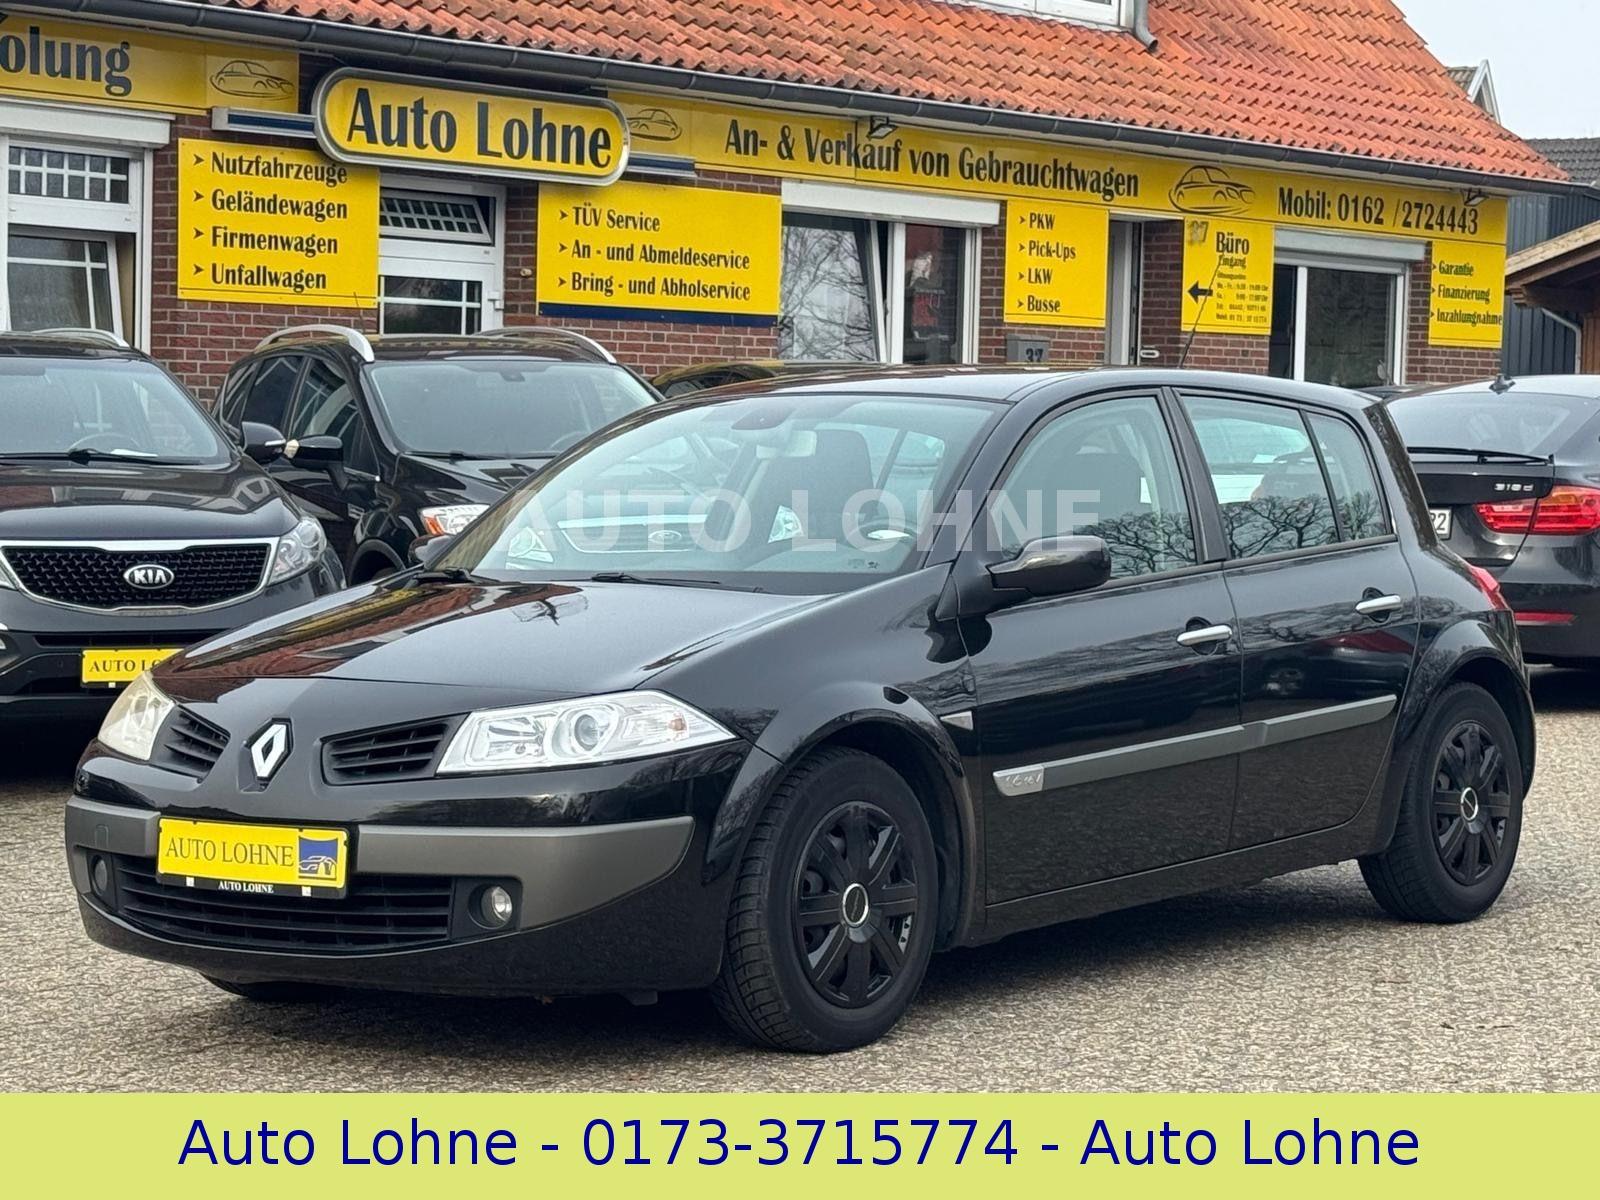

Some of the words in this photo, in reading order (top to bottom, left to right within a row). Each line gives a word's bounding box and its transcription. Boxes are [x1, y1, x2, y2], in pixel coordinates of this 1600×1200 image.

[0, 26, 131, 96] olung
[347, 88, 457, 153] Auto
[477, 101, 611, 168] Lohne
[212, 152, 348, 187] Nutzfahrzeuge
[725, 119, 768, 156] An-
[777, 130, 795, 160] &
[805, 133, 902, 172] Verkauf
[910, 149, 949, 178] von
[959, 147, 1139, 200] Gebrauchtwagen
[212, 188, 348, 222] Geländewagen
[573, 202, 601, 227] TÜV
[607, 209, 660, 232] Service
[1278, 187, 1331, 220] Mobil:
[1338, 193, 1384, 225] 0162
[1030, 213, 1055, 230] PKW
[212, 226, 338, 257] Firmenwagen
[1029, 240, 1076, 260] Pick-Ups
[1216, 232, 1249, 255] Büro
[572, 243, 591, 259] An
[607, 247, 634, 262] und
[639, 245, 750, 270] Abmeldeservice
[1439, 260, 1474, 276] Garantie
[212, 263, 327, 292] Unfallwagen
[572, 272, 613, 296] Bring
[629, 280, 655, 295] und
[661, 278, 750, 301] Abholservice
[1028, 268, 1052, 285] LKW
[1027, 296, 1060, 313] Busse
[1438, 284, 1490, 304] Finanzierung
[1026, 348, 1043, 362] 37
[134, 569, 167, 584] KIA
[90, 660, 135, 672] AUTO
[166, 837, 216, 861] AUTO
[222, 842, 294, 867] LOHNE
[218, 881, 241, 892] AUTO
[243, 883, 274, 894] LOHNE
